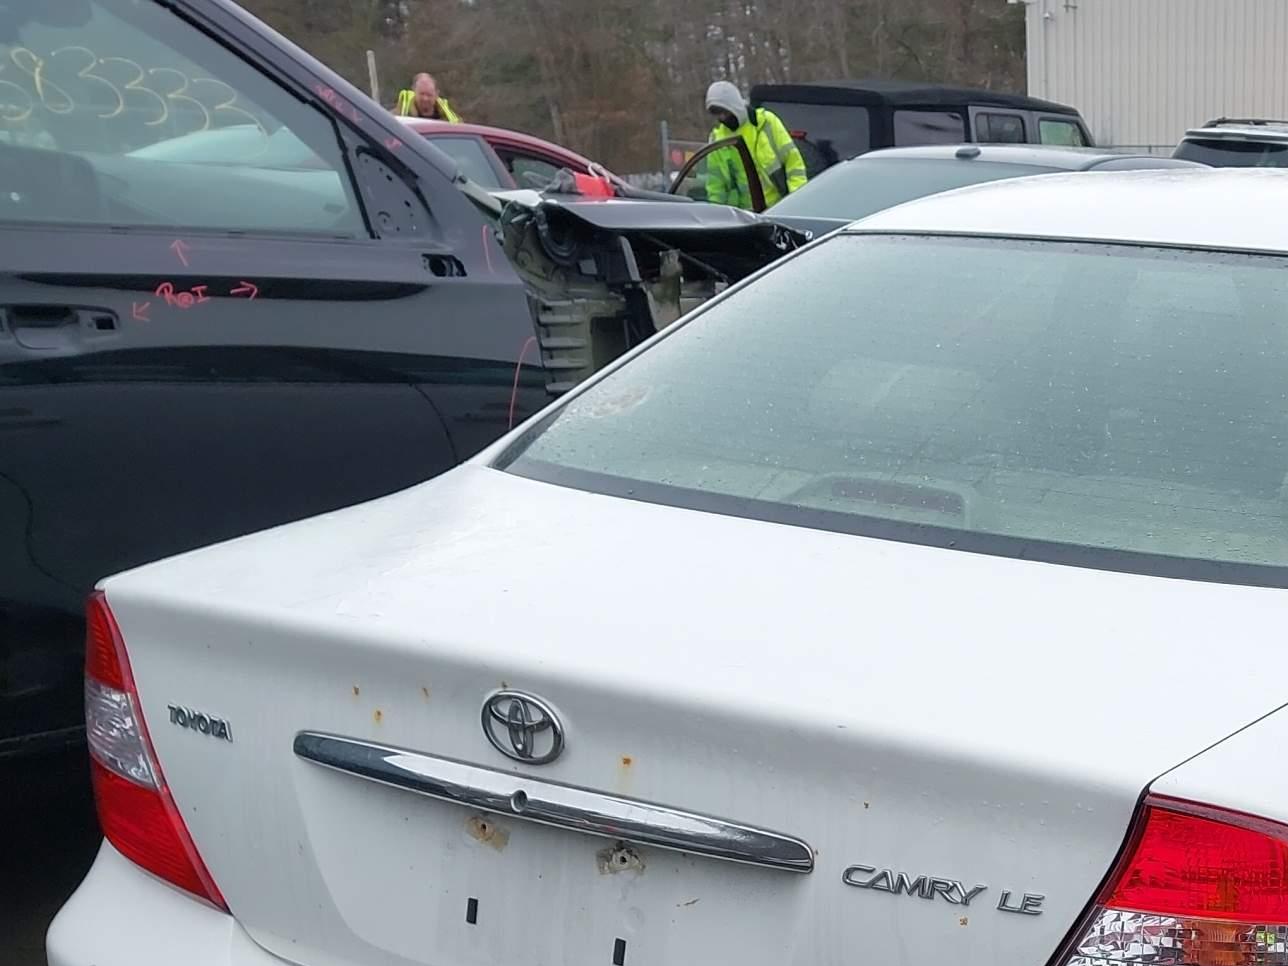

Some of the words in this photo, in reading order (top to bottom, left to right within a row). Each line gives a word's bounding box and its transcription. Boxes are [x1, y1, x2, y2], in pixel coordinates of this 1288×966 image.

[167, 703, 233, 743] TOYOTA
[842, 864, 988, 906] CAMRY
[996, 889, 1046, 915] LE
